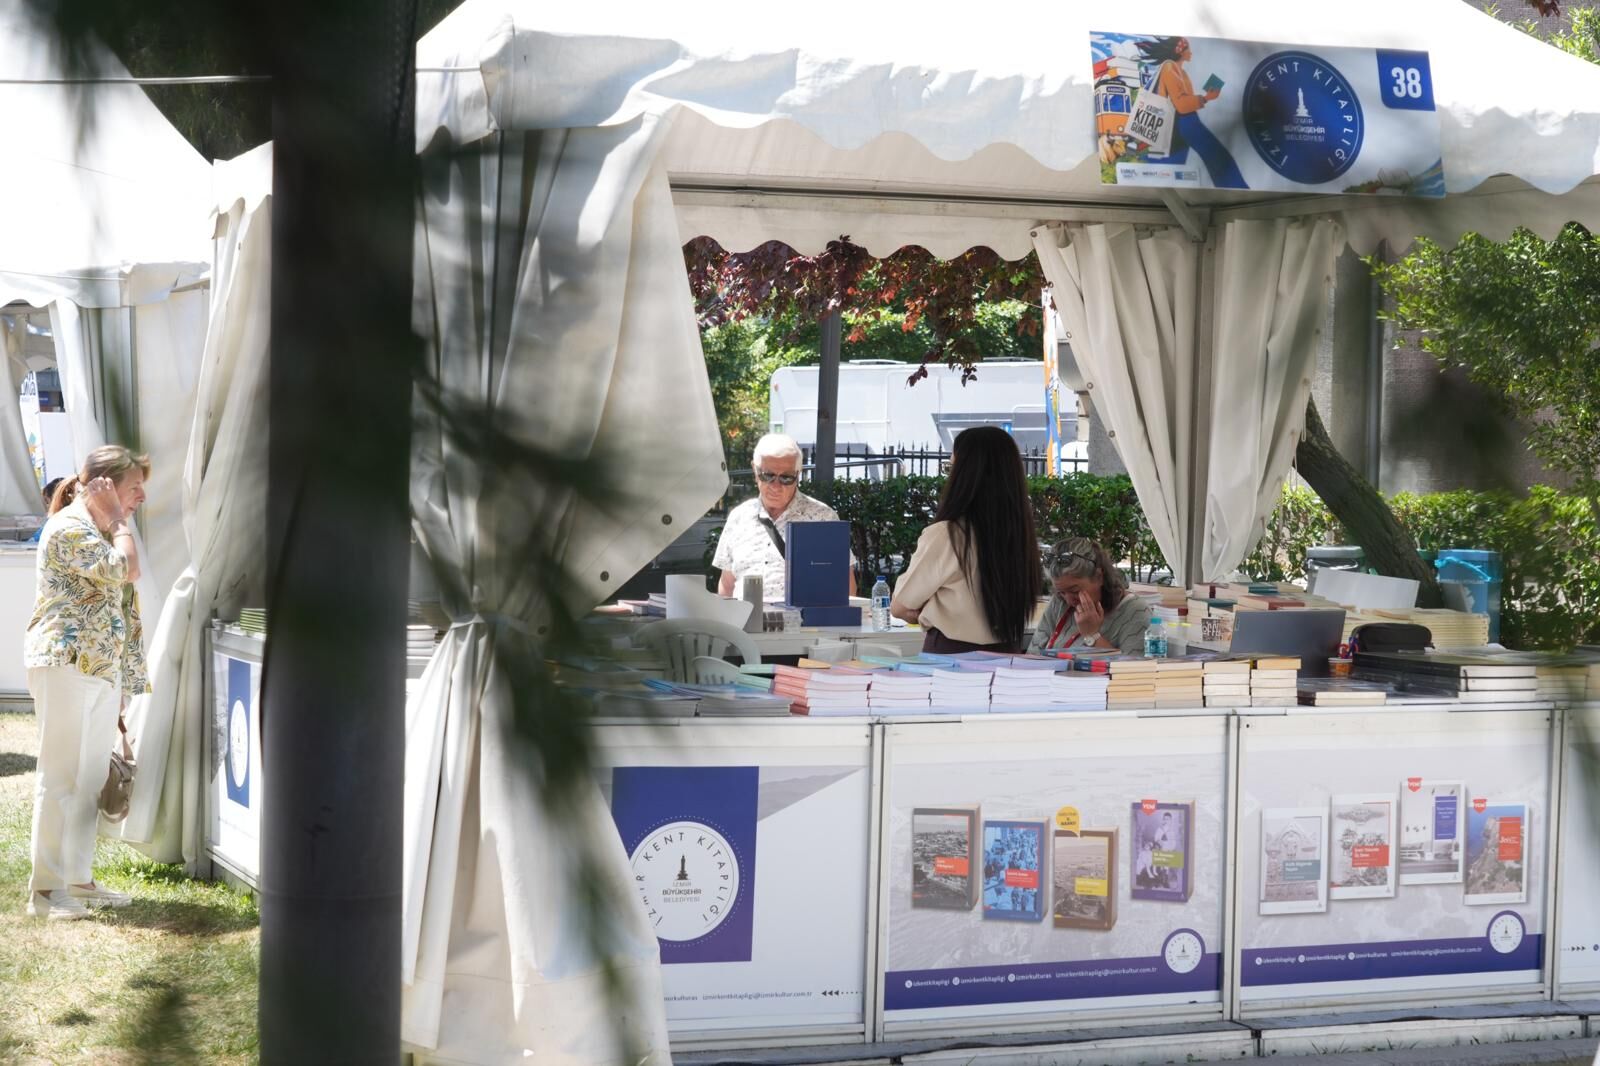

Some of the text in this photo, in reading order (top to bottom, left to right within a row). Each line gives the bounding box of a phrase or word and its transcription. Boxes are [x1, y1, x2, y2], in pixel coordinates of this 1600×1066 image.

[1391, 66, 1422, 98] 38
[1134, 108, 1164, 131] KİTAP
[643, 832, 685, 862] KENT
[662, 887, 702, 896] BÜYÜKŞEHİR
